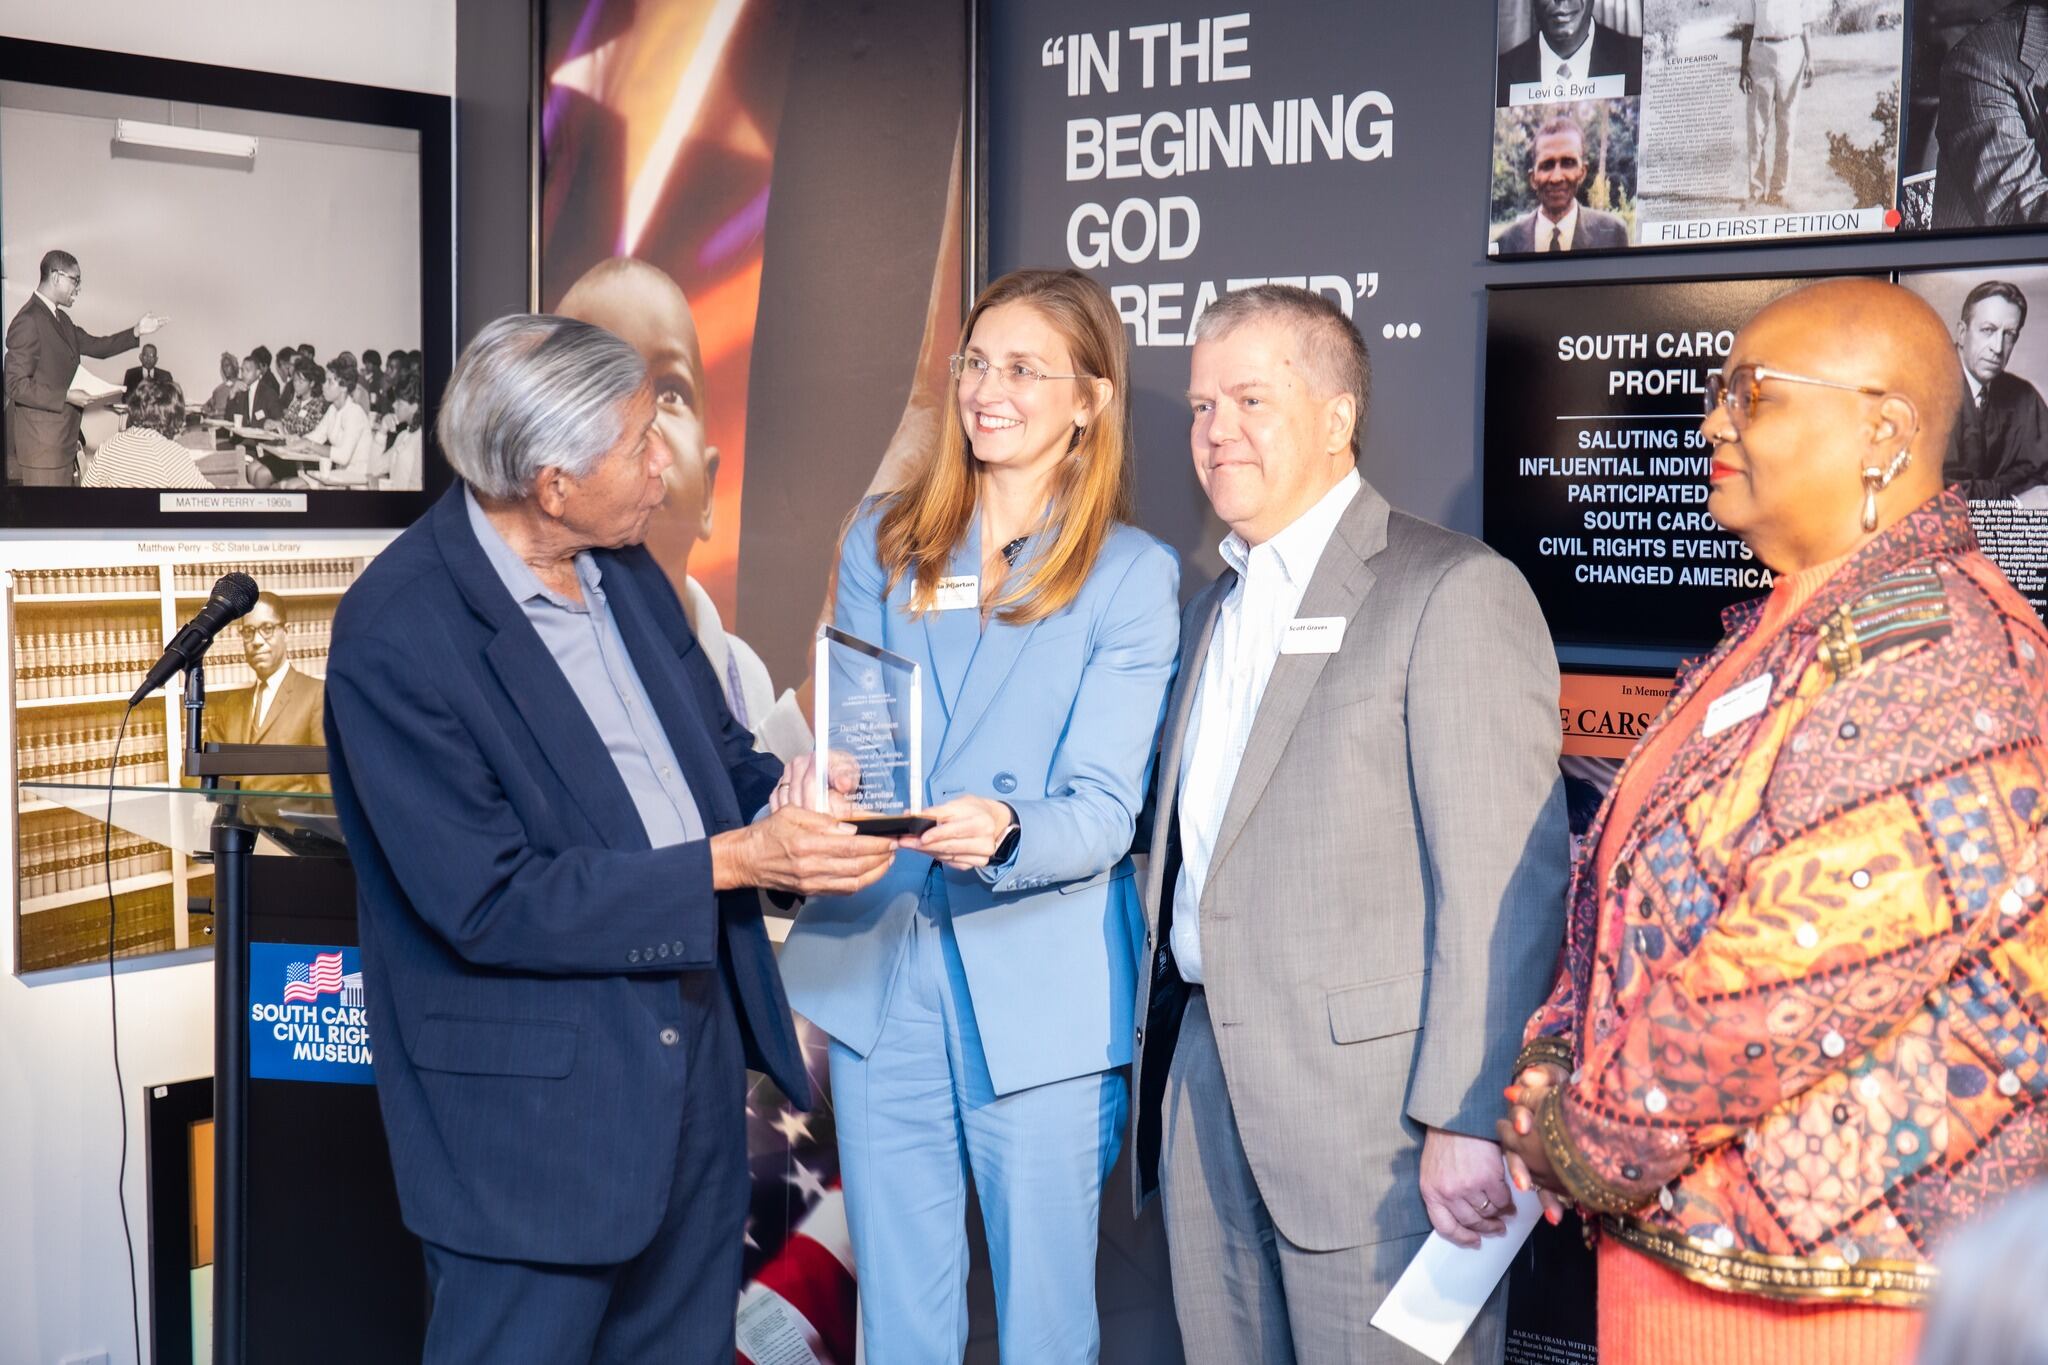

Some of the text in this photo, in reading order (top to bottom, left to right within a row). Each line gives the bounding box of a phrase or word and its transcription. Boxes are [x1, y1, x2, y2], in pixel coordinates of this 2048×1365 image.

[1042, 13, 1251, 96] “IN THE
[1667, 54, 1718, 65] LEVI PEARSON
[1528, 82, 1596, 99] Levi G. Byrd
[1066, 90, 1394, 181] BEGINNING
[1066, 196, 1200, 270] GOD
[1662, 213, 1860, 240] FILED FIRST PETITION
[1558, 334, 1648, 361] SOUTH
[1578, 430, 1707, 449] SALUTING 50
[1519, 457, 1713, 476] INFLUENTIAL INDIVI
[176, 498, 220, 508] MATHEW
[222, 498, 255, 508] PERRY
[267, 498, 292, 507] 1960s
[1568, 484, 1709, 504] PARTICIPATED
[1968, 500, 1986, 508] ITES
[1584, 511, 1651, 530] SOUTH
[137, 543, 175, 553] Matthew
[178, 543, 201, 554] Perry
[212, 543, 226, 552] SC
[228, 543, 250, 552] State
[252, 543, 270, 552] Law
[272, 543, 301, 554] Library
[1539, 537, 1753, 560] CIVIL RIGHTS EVENTS
[1575, 565, 1774, 588] CHANGED AMERICA
[1622, 685, 1671, 697] In Memor
[1577, 709, 1652, 736] CARS
[252, 1003, 317, 1024] SOUTH
[273, 1022, 324, 1043] CIVIL
[293, 1042, 373, 1065] MUSEUM
[1513, 1329, 1540, 1340] BARACK
[1541, 1335, 1566, 1346] OBAMA
[1568, 1340, 1587, 1350] WITH
